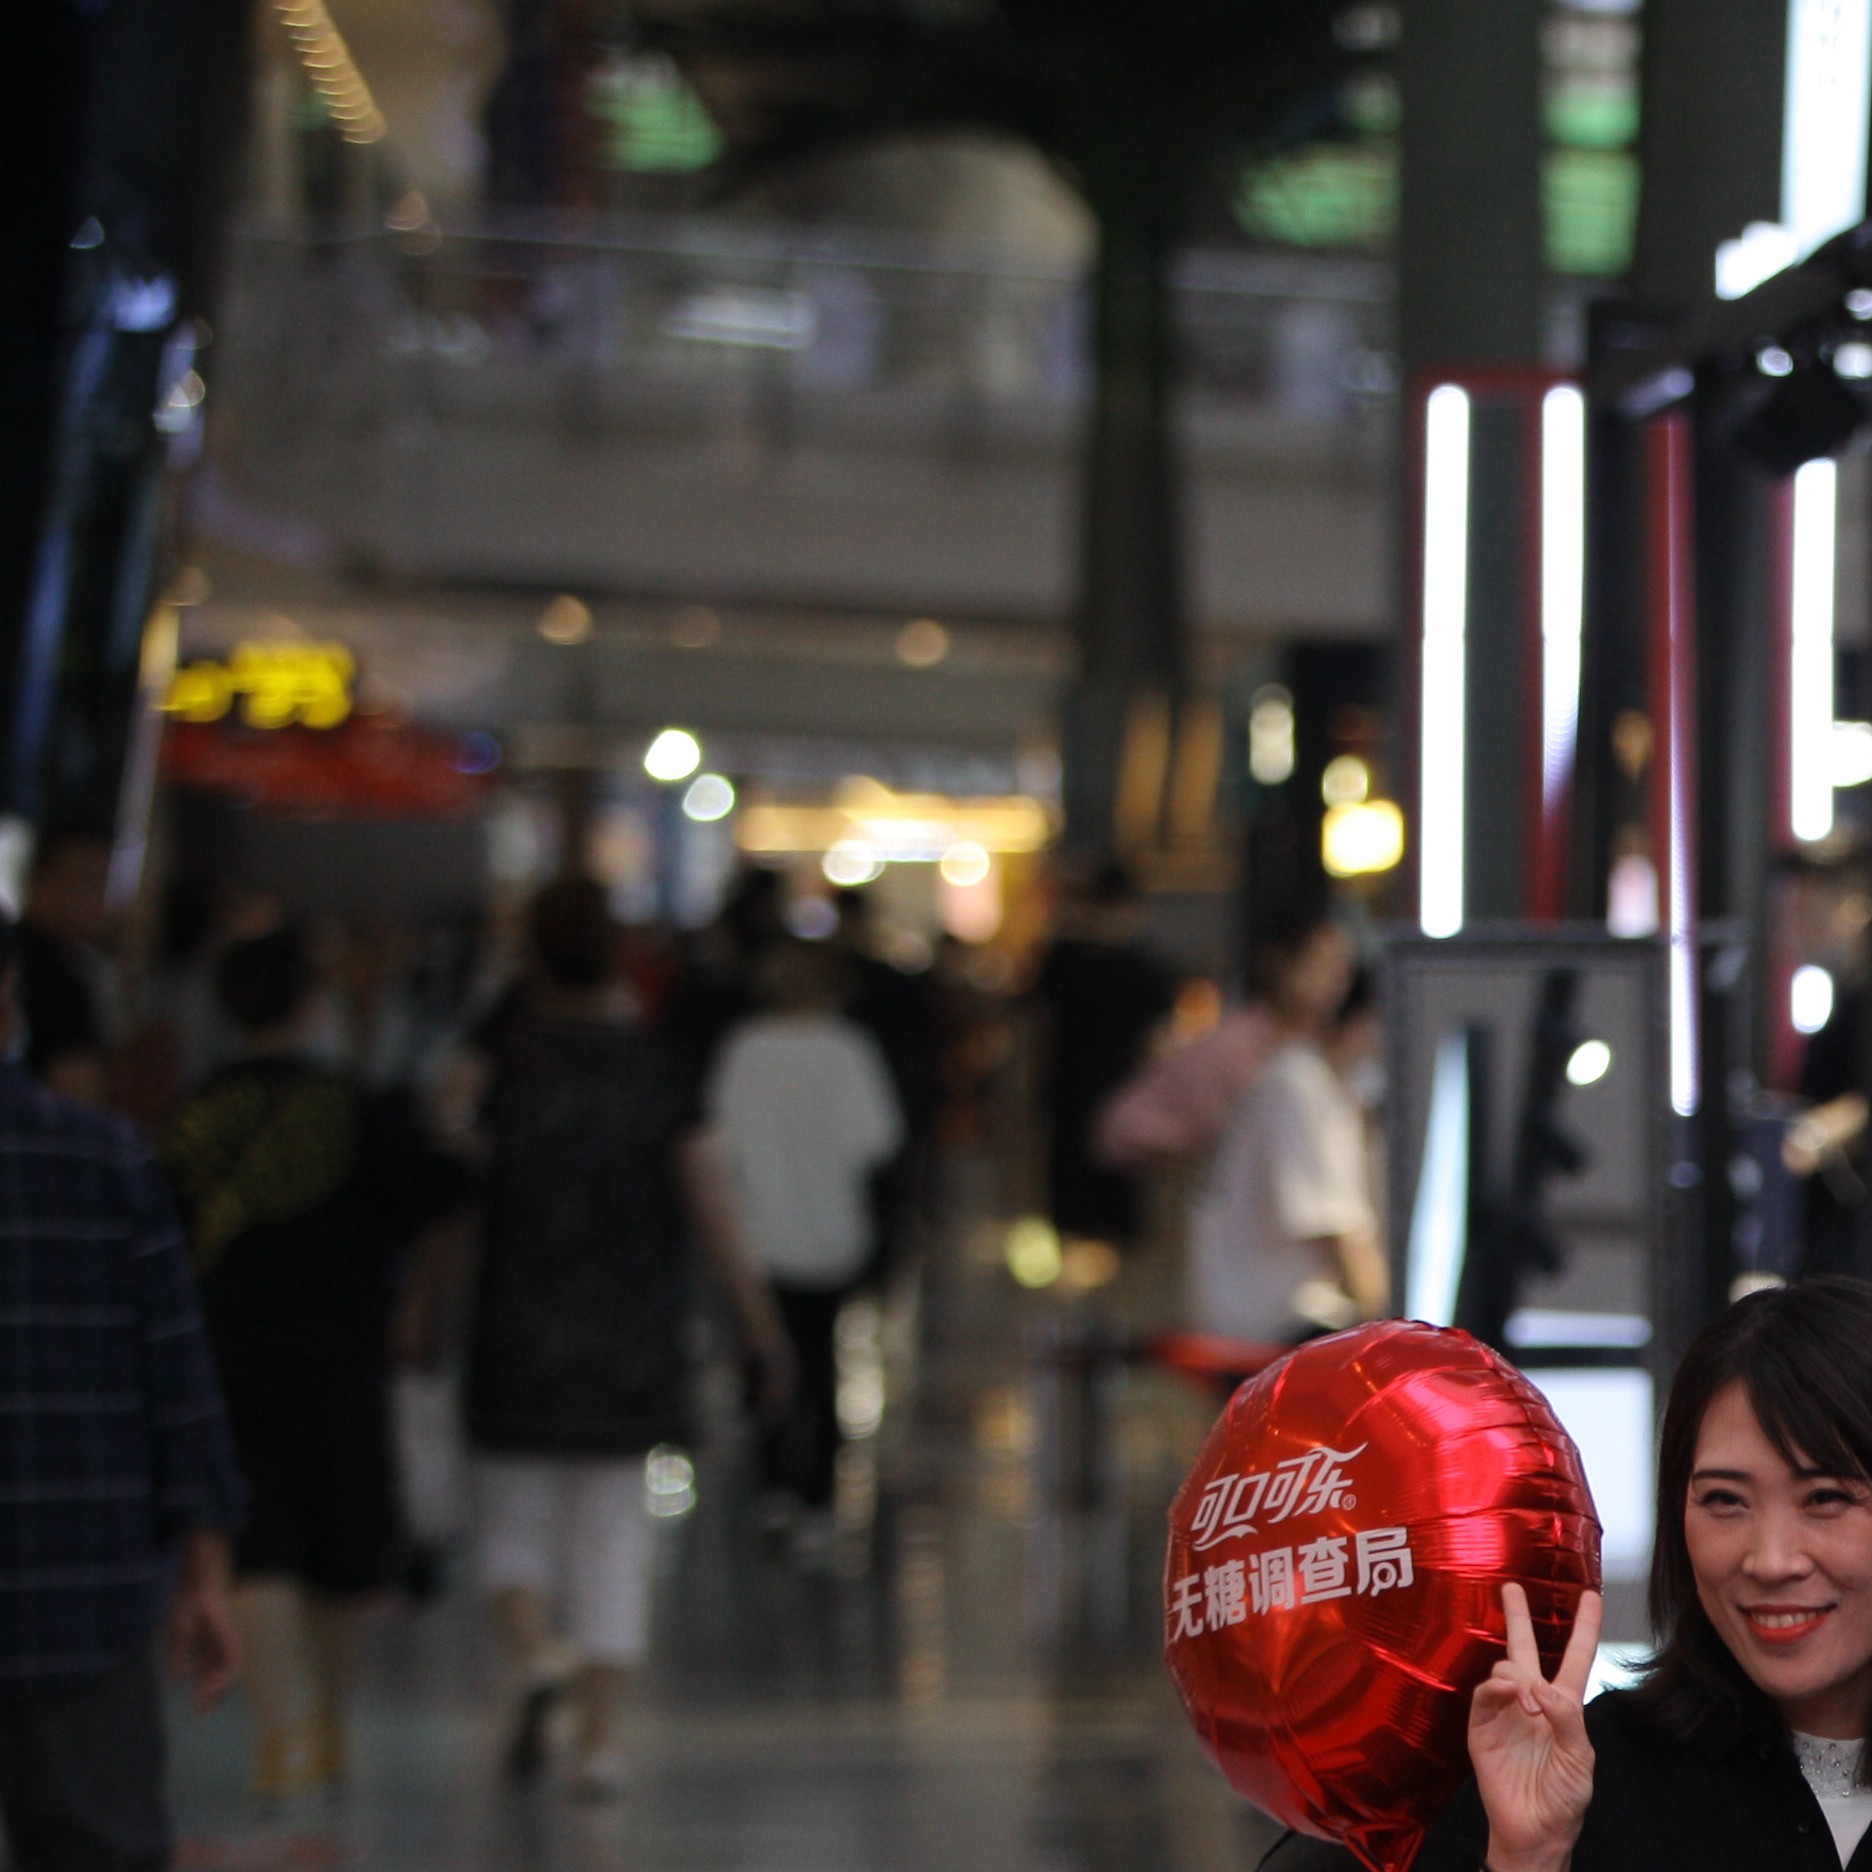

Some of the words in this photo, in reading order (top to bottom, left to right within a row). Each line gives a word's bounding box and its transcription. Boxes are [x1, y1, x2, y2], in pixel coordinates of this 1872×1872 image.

[1191, 1441, 1368, 1551] 可口可乐
[1169, 1526, 1416, 1642] 无糖调查局
